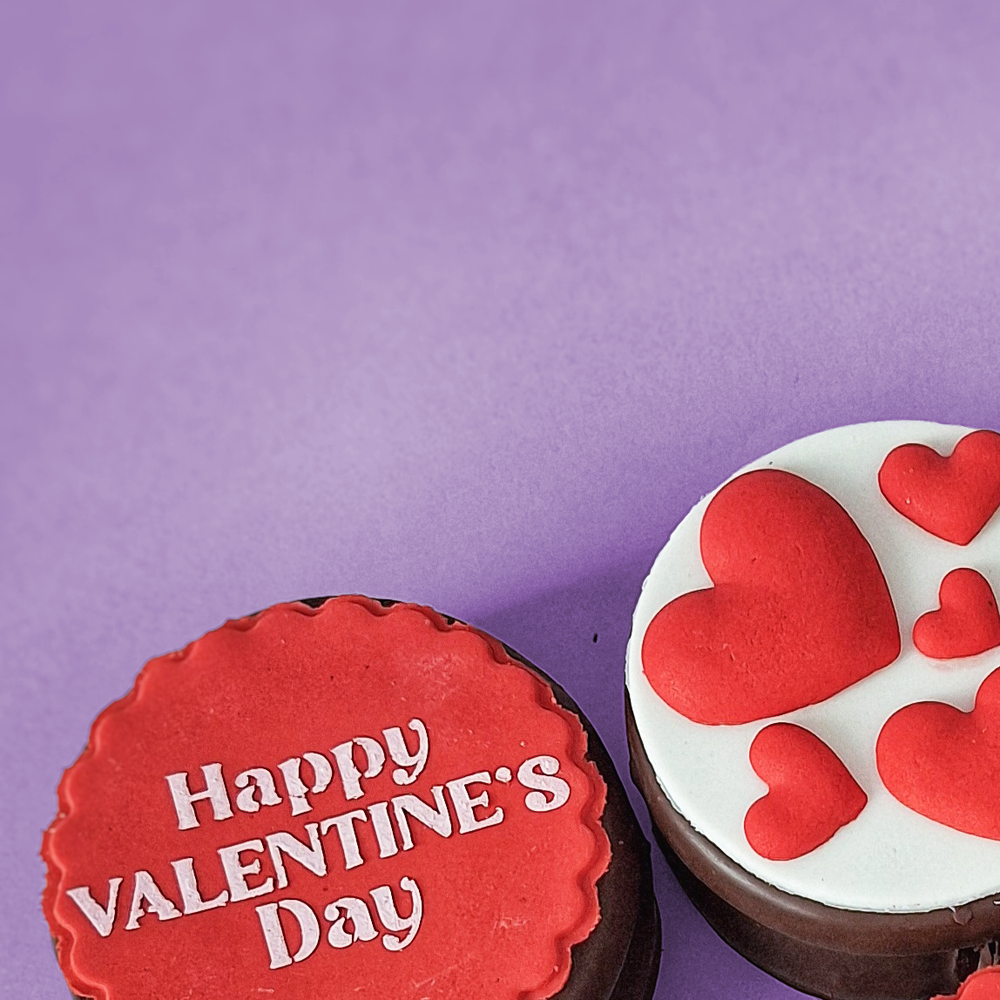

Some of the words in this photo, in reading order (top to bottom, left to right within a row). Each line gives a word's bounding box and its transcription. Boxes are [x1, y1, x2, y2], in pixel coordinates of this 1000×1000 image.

[164, 718, 430, 830] Happy
[66, 755, 571, 938] VALENTINE'S
[255, 876, 424, 970] Day
